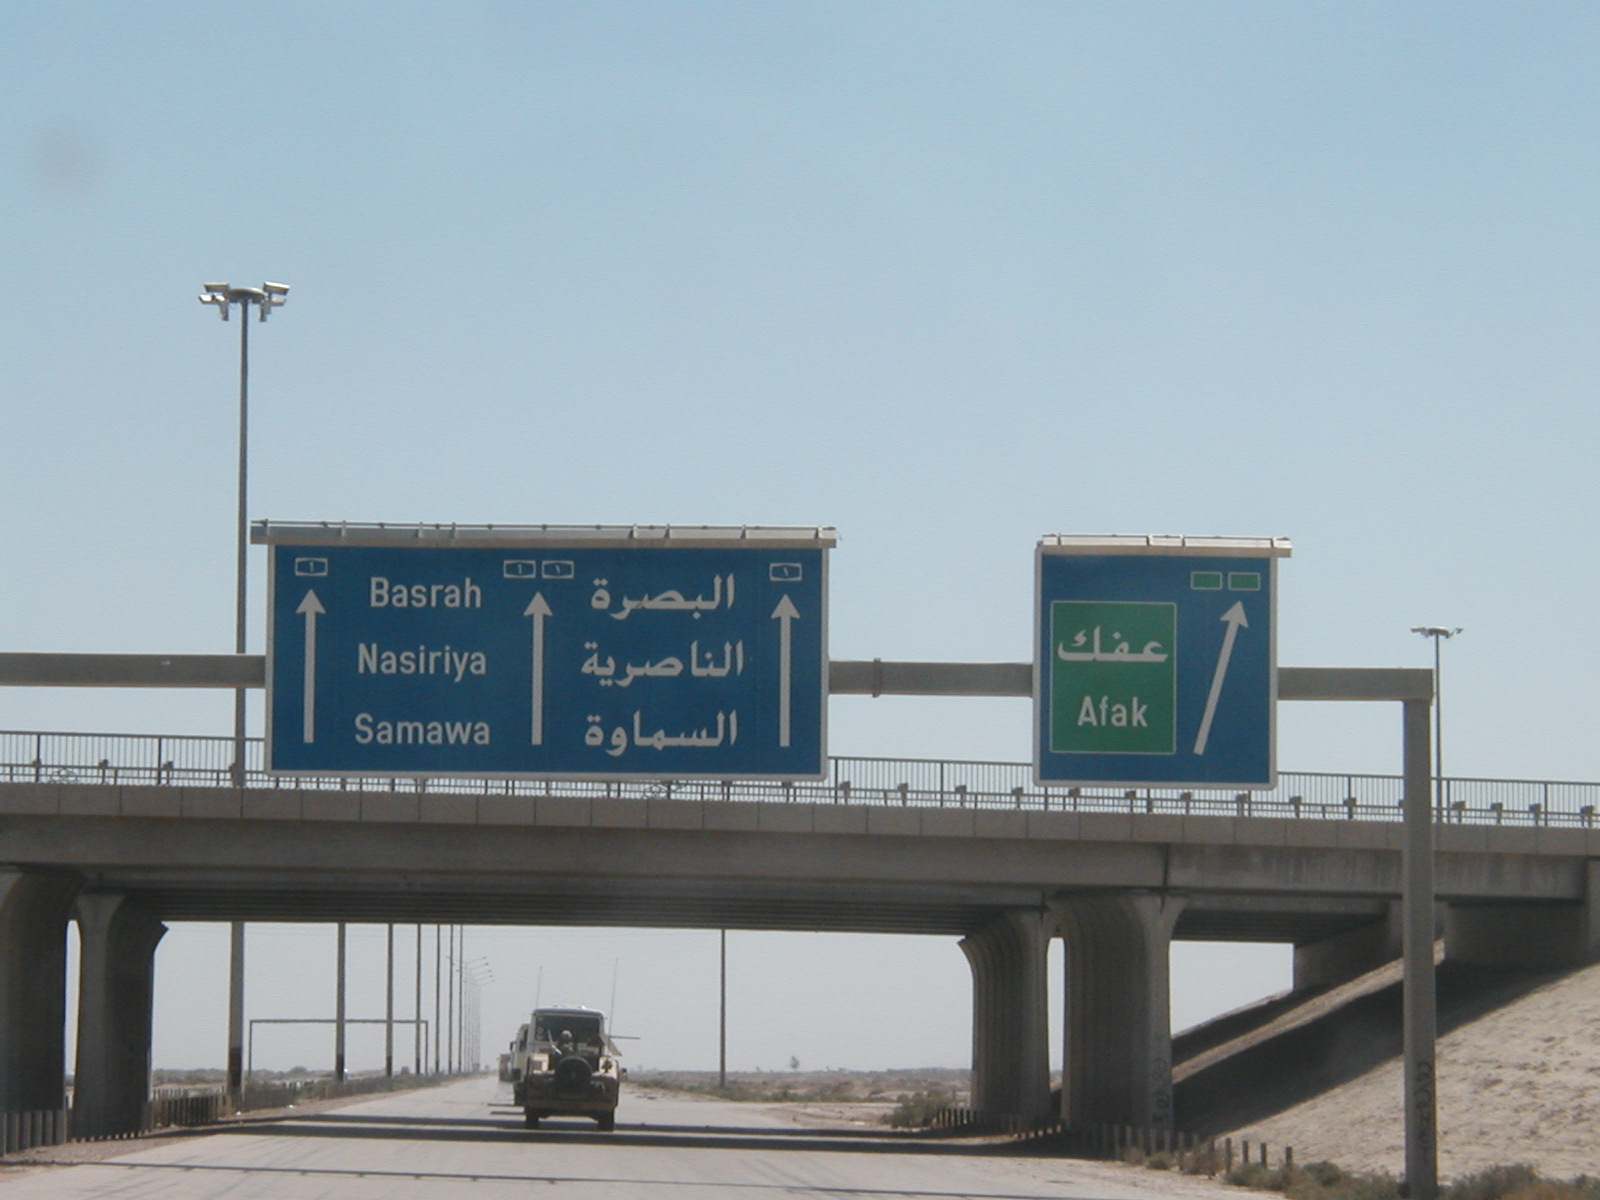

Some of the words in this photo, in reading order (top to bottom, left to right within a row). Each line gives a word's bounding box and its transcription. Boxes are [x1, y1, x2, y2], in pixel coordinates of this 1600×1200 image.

[370, 576, 482, 608] Basrah
[590, 573, 735, 621] البصرة
[358, 642, 487, 683] Nasiriya
[580, 640, 744, 687] الناصرية
[1057, 626, 1169, 663] عفك
[354, 712, 490, 745] Samawa
[1078, 695, 1148, 728] Afak
[584, 710, 738, 757] السماوة
